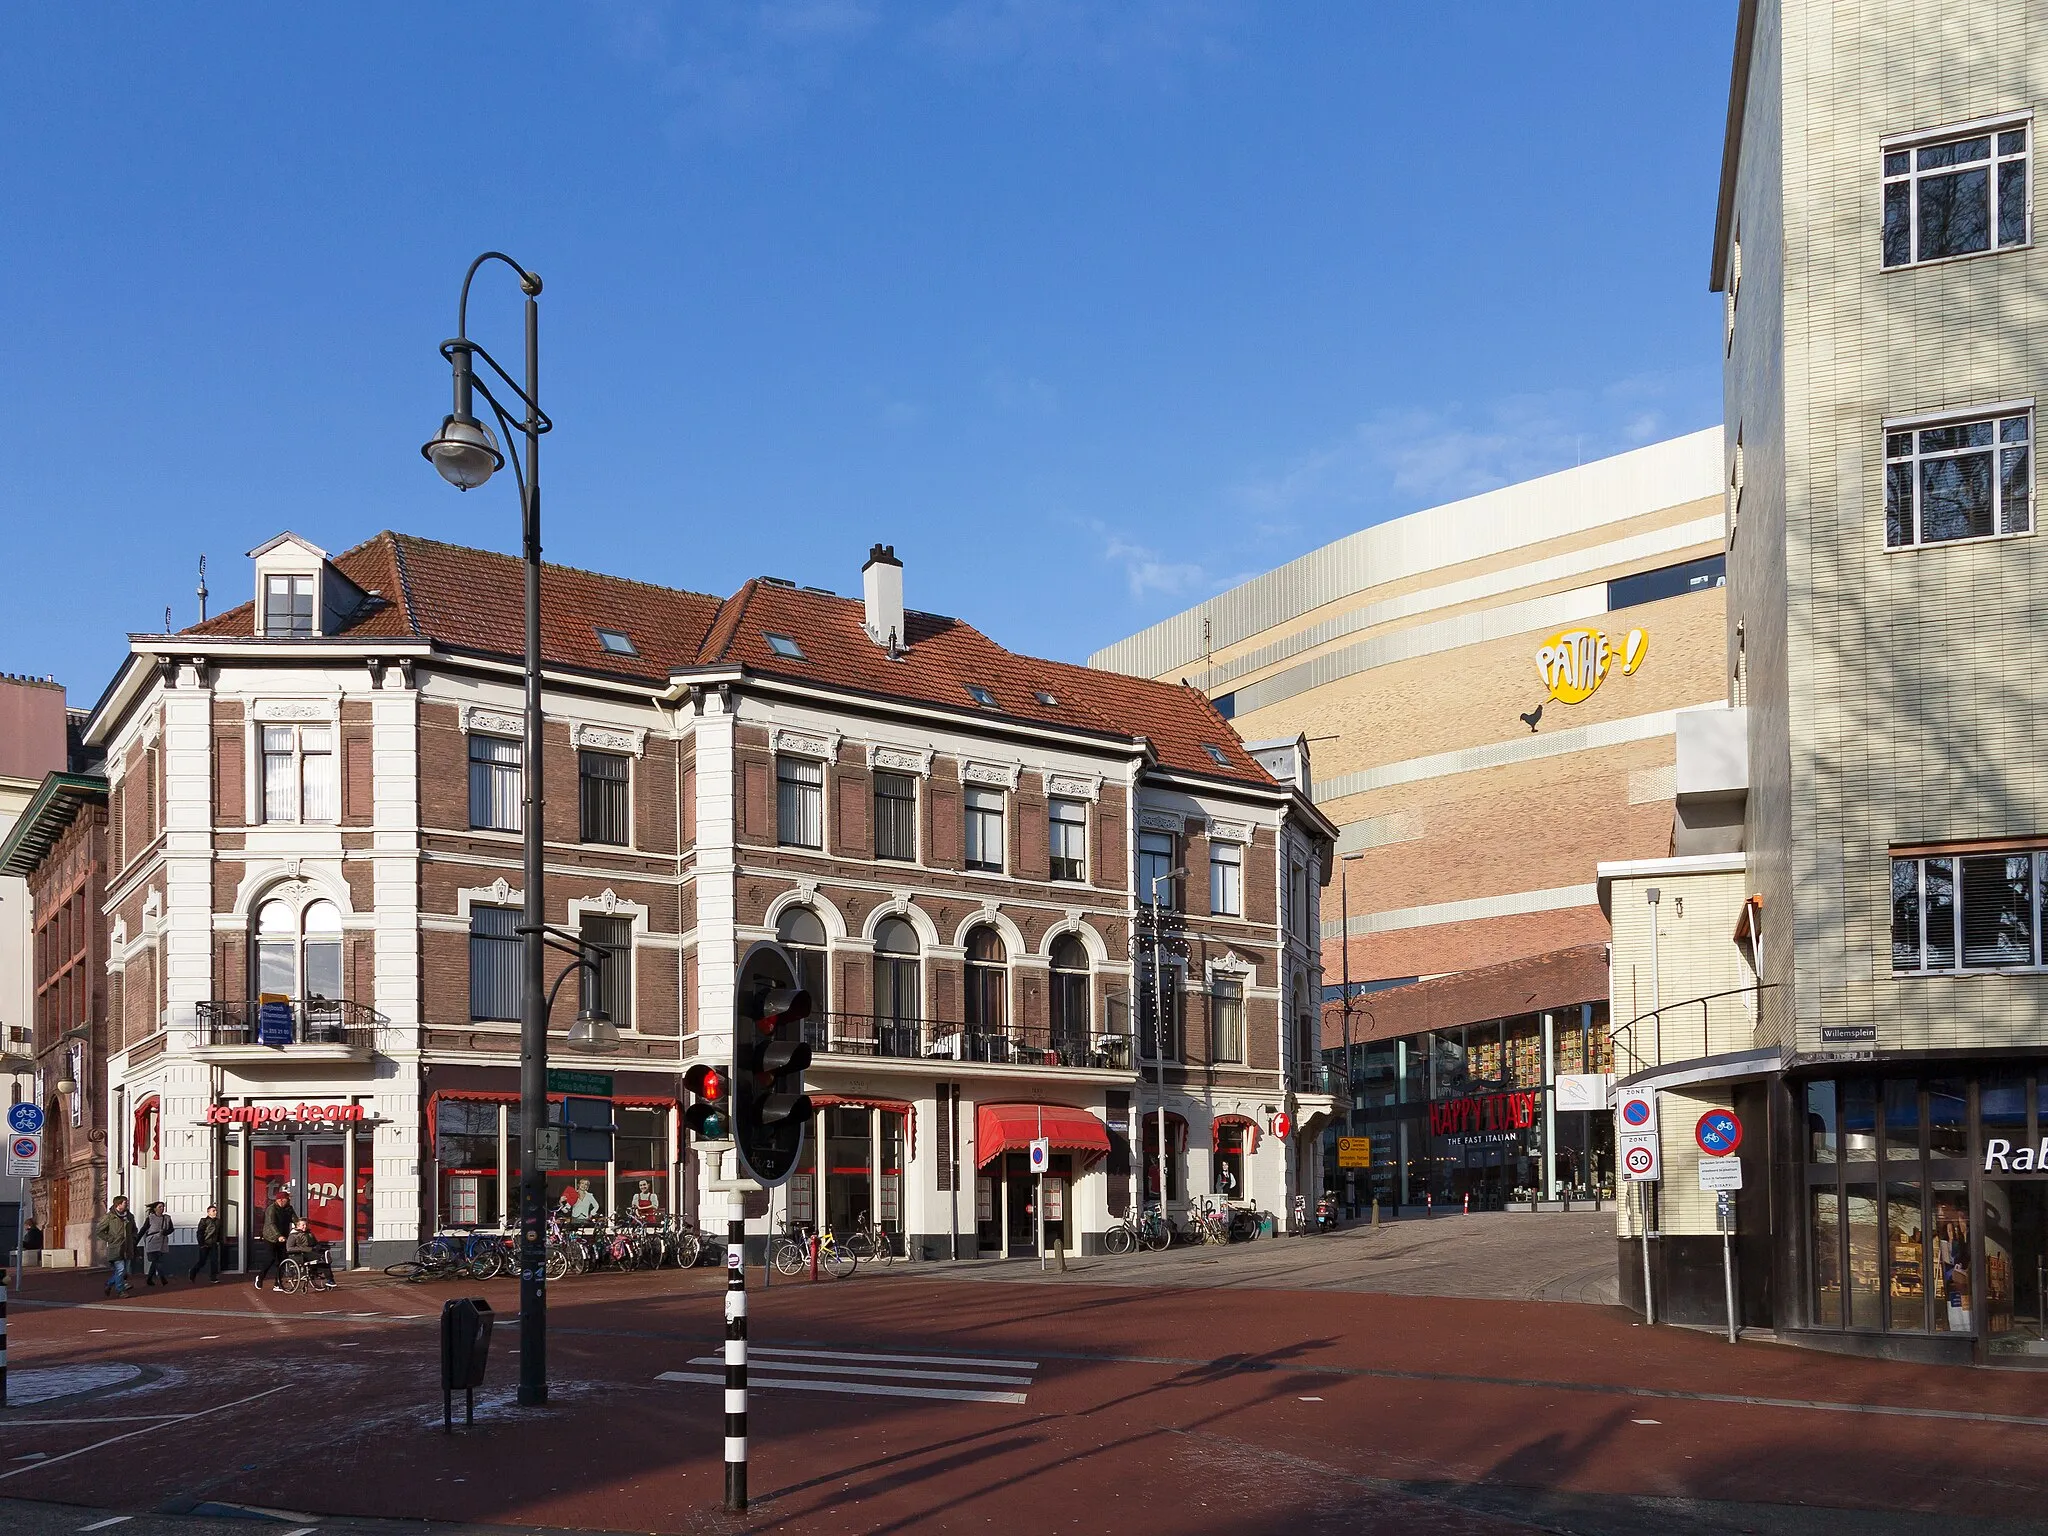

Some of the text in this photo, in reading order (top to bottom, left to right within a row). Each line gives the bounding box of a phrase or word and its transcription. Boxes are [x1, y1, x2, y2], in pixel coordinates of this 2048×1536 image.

[1824, 1029, 1874, 1038] Willemsplein
[205, 1102, 365, 1129] tempo-team
[1428, 1090, 1536, 1137] HAPPY ITALY
[1448, 1132, 1516, 1146] THE FAST ITALIAN
[1631, 1155, 1647, 1165] 30
[1984, 1137, 2048, 1170] Rab
[766, 1159, 774, 1168] 21
